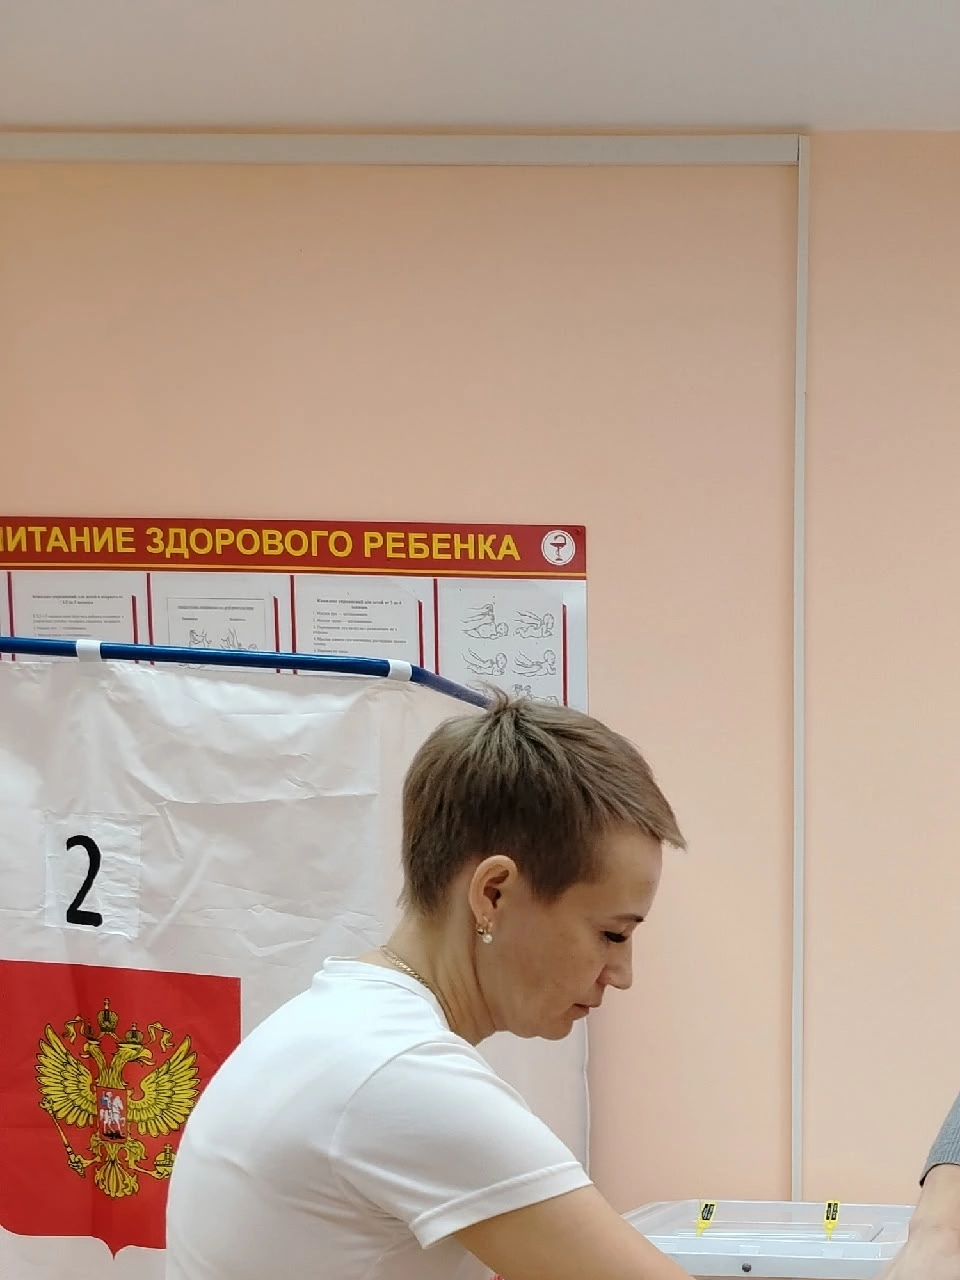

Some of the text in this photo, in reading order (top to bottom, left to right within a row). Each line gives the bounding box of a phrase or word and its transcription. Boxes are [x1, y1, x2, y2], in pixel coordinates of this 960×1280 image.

[0, 526, 521, 561] ИТАНИЕ ЗДОРОВОГО РЕБЕНКА
[66, 835, 103, 927] 2
